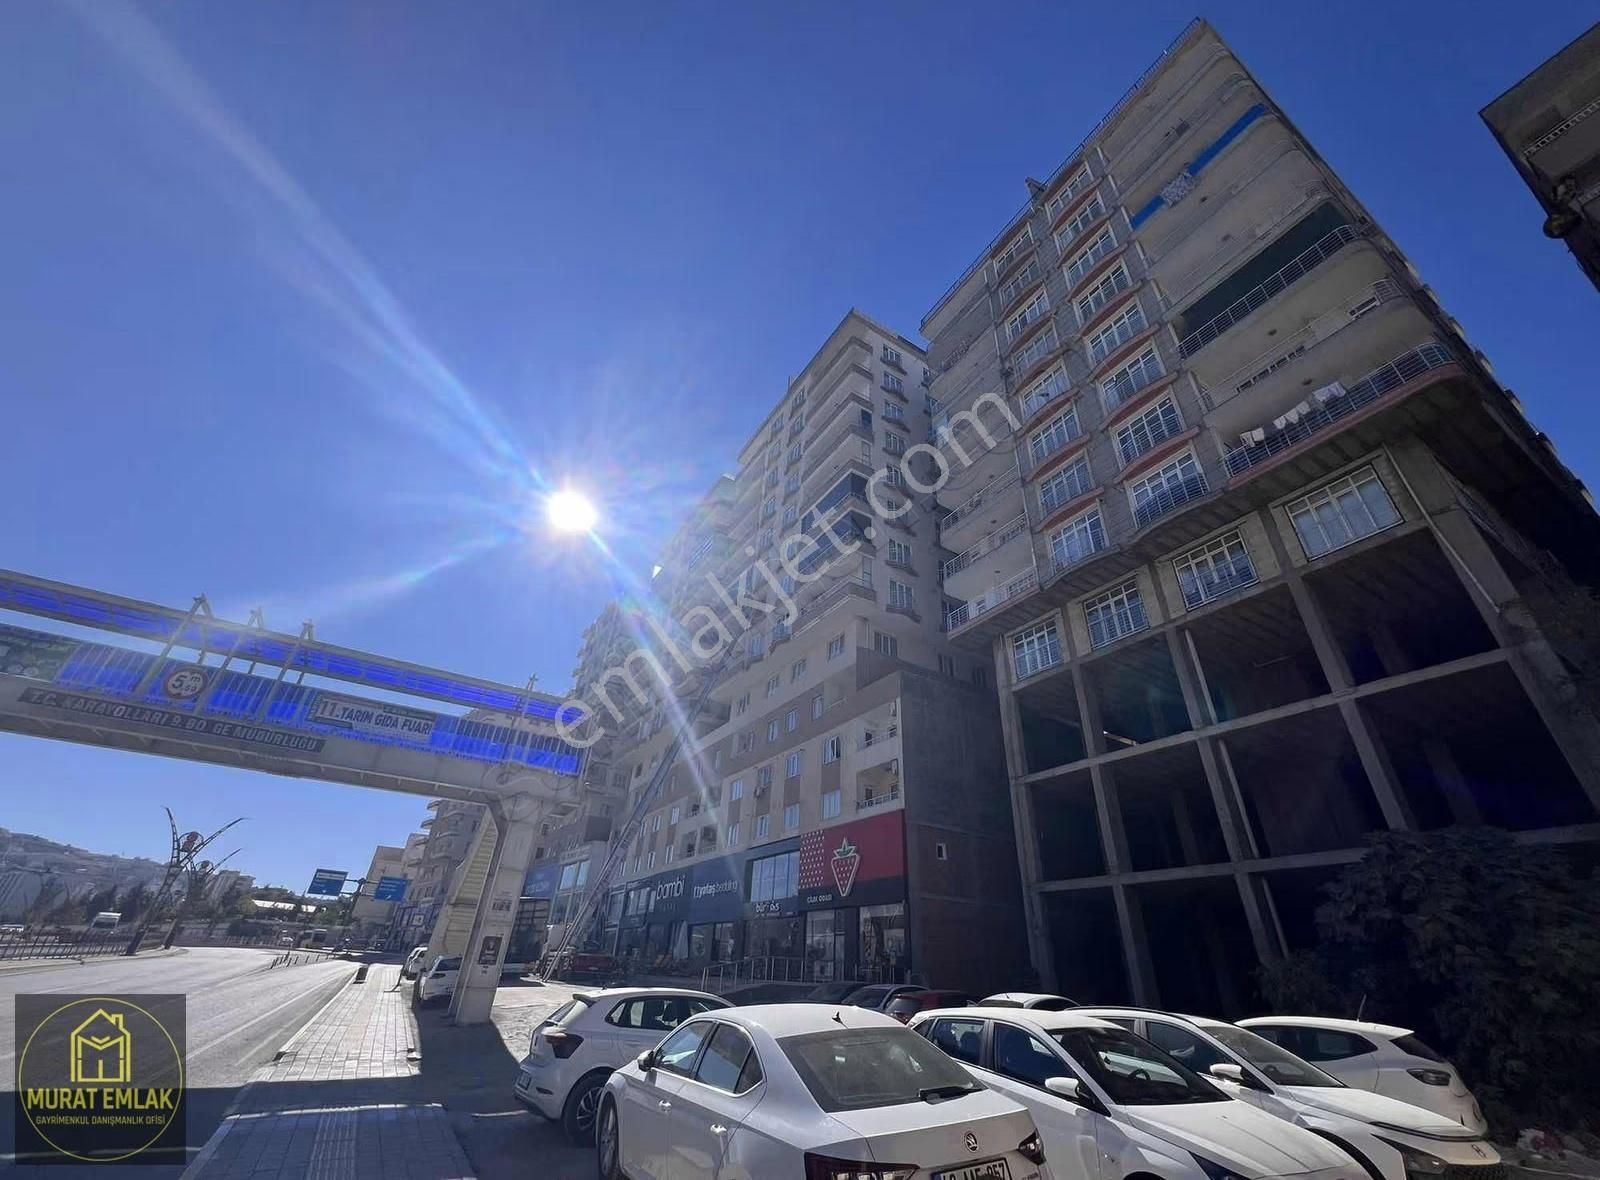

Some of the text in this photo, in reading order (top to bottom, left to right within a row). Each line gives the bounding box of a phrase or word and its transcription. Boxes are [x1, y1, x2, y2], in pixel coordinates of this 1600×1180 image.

[62, 697, 168, 726] KARAYOLLARI
[340, 707, 372, 723] TARIM
[374, 711, 399, 729] GIDA
[656, 875, 686, 900] bambi
